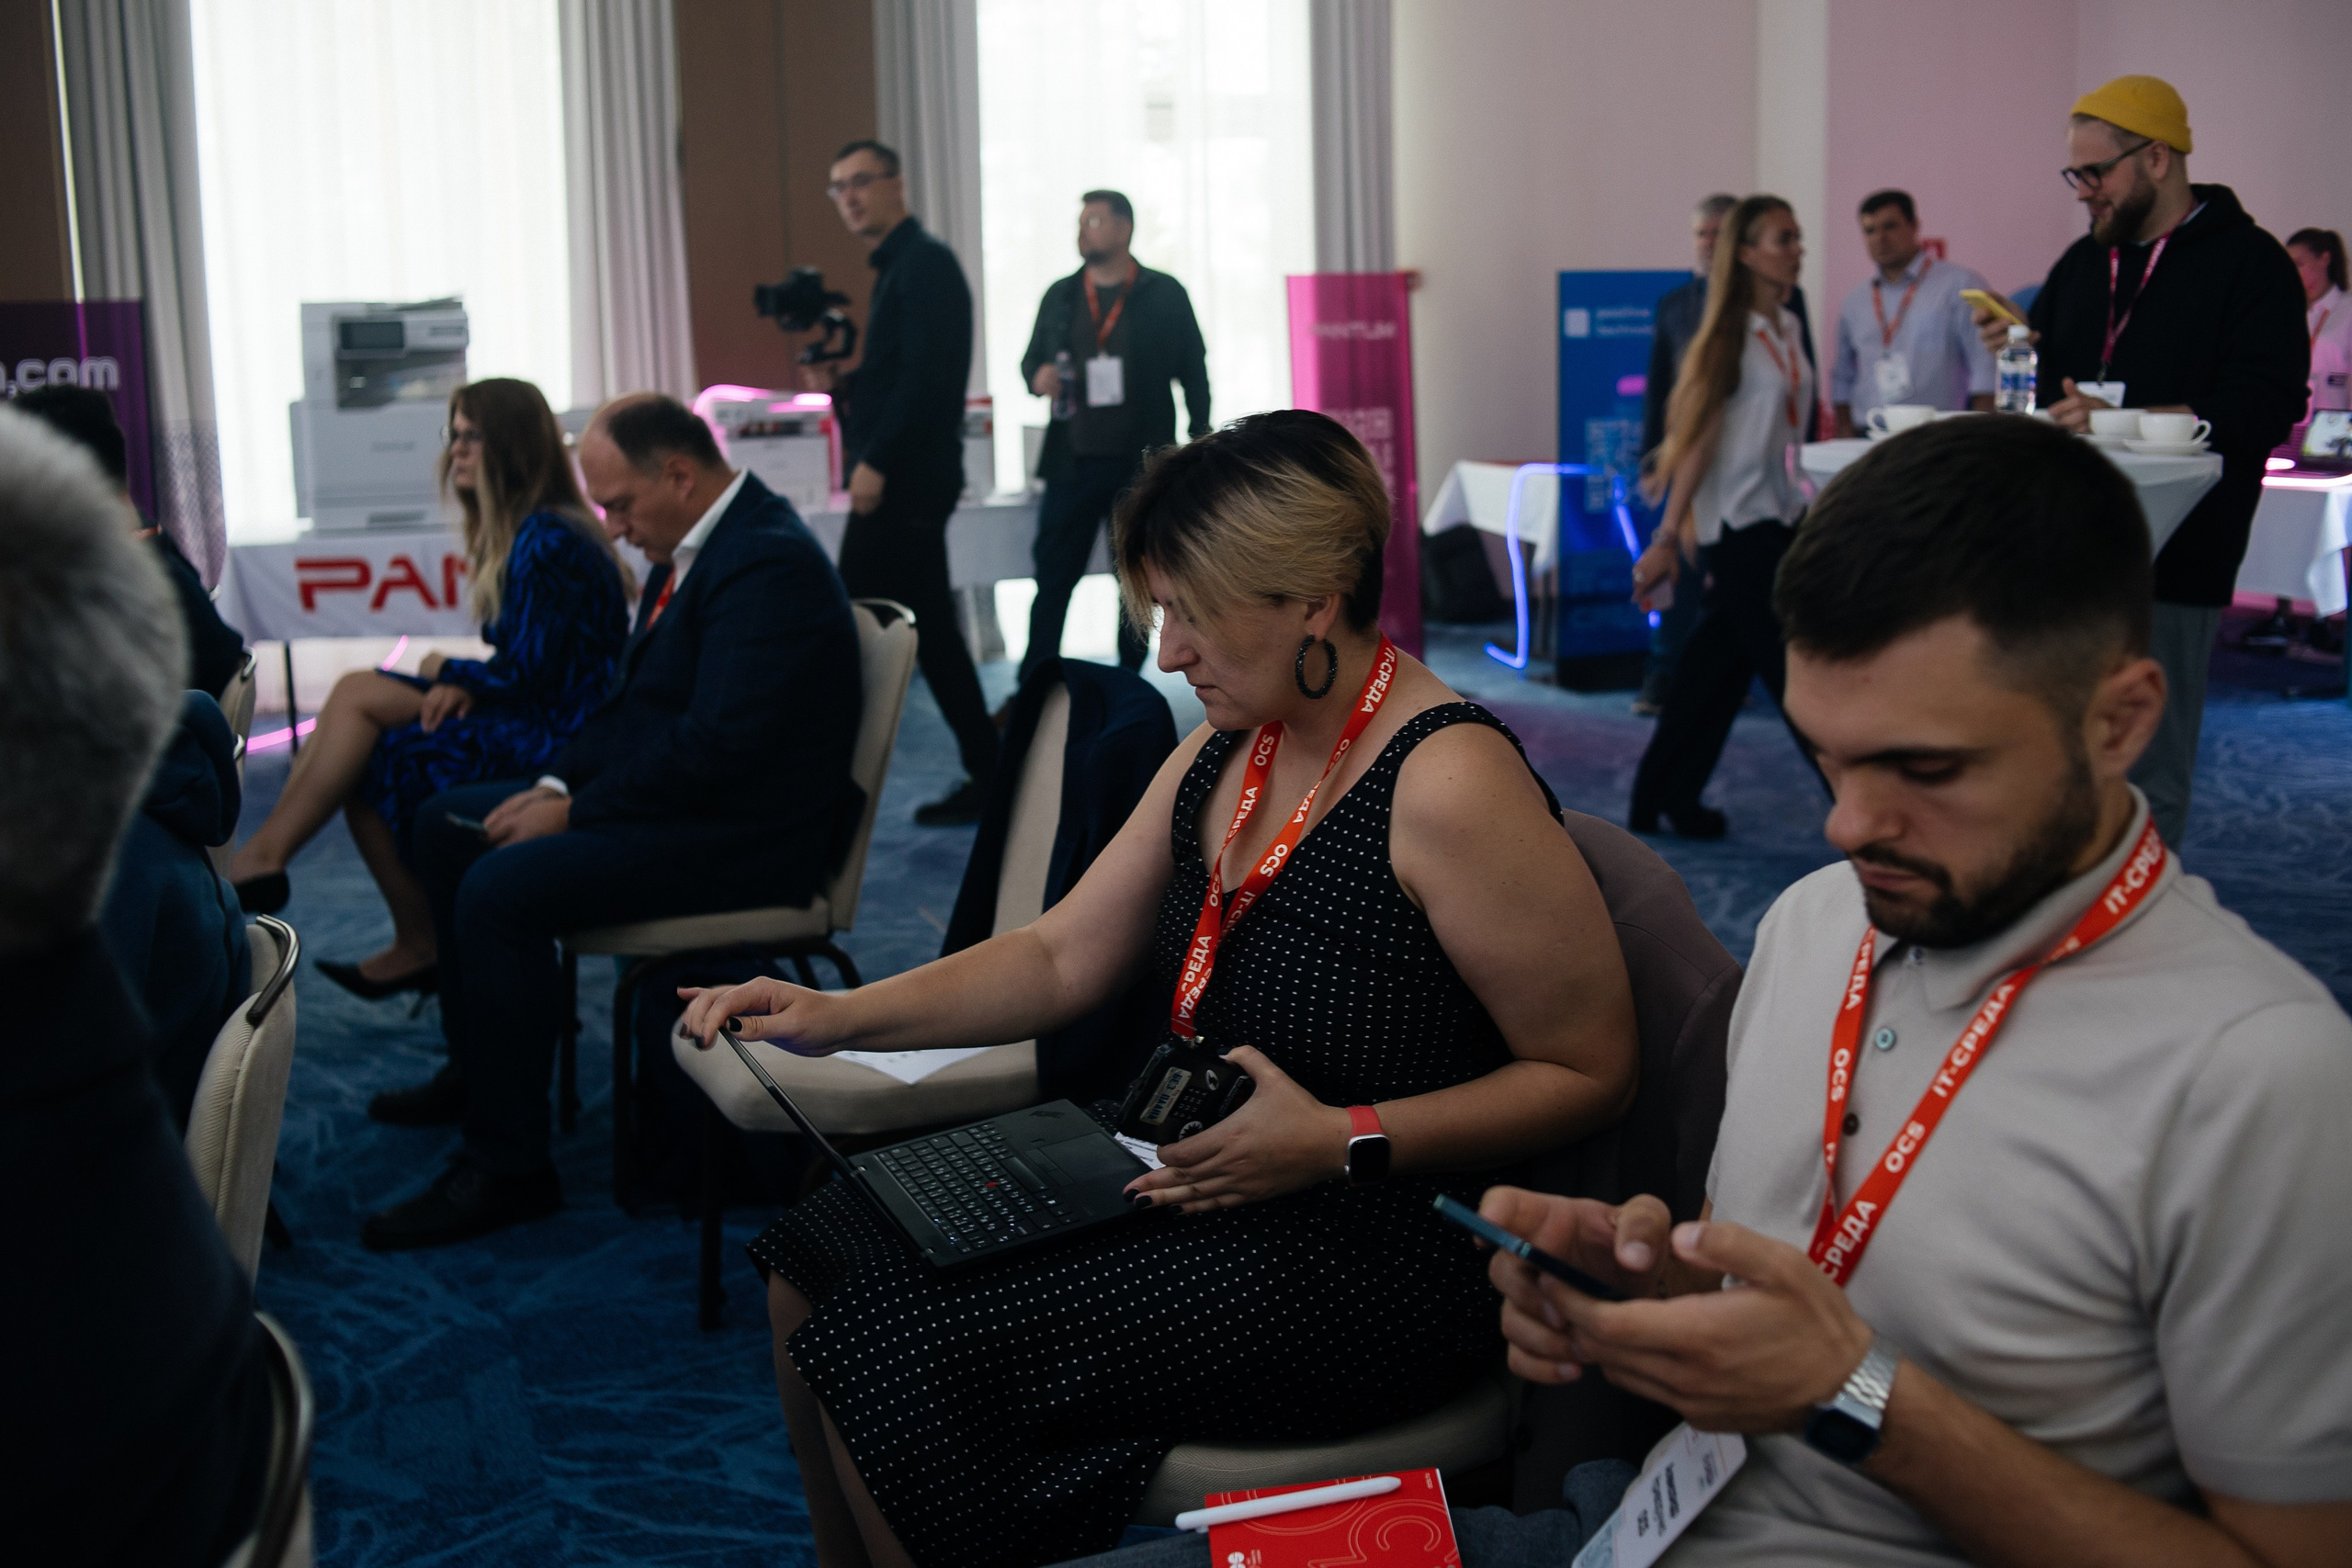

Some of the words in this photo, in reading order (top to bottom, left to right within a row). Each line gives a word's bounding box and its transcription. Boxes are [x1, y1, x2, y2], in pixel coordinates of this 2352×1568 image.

[1361, 647, 1396, 713] IT-СРЕДА
[1254, 734, 1274, 767] OCS
[1260, 843, 1288, 877] OCS
[1830, 1048, 1850, 1102] OCS
[1884, 1120, 1926, 1174] OCS
[1932, 983, 2015, 1099] IT-СРЕДА
